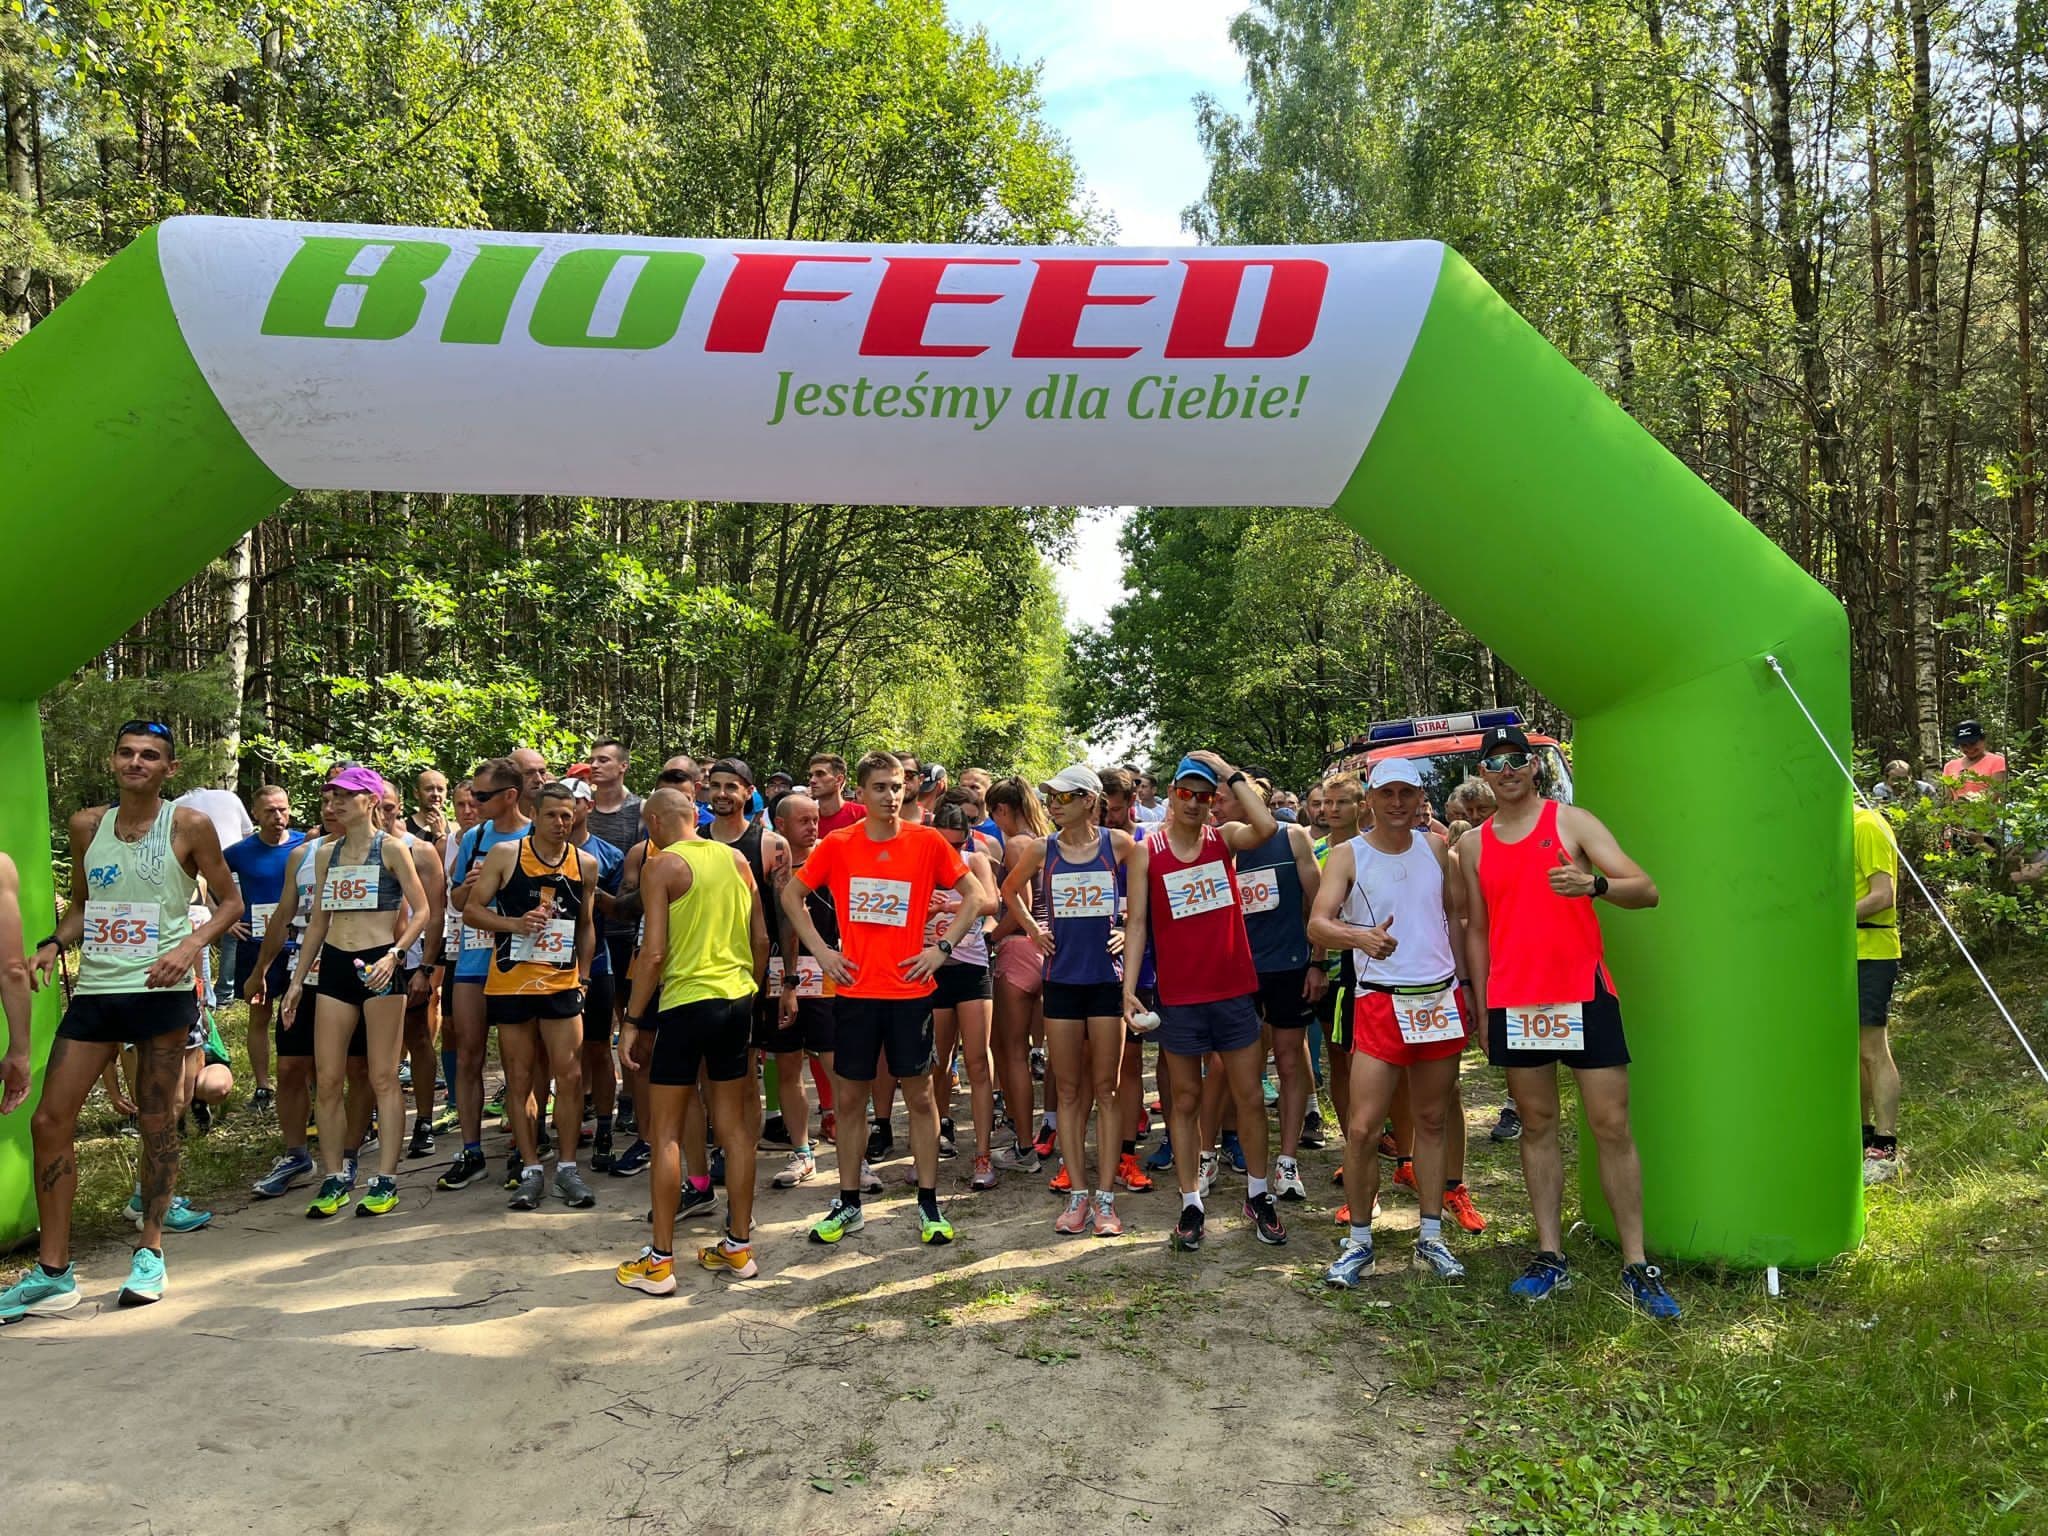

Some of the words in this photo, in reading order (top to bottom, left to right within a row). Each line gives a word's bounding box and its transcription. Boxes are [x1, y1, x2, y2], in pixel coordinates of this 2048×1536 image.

[260, 236, 1330, 359] BIOFEED
[767, 370, 1012, 431] Jesteśmy
[1025, 373, 1108, 420] dla
[1127, 373, 1311, 420] Ciebie!
[331, 879, 368, 900] 185
[1063, 885, 1104, 907] 212
[1181, 878, 1218, 906] 211
[1240, 883, 1269, 905] 90
[856, 891, 900, 915] 222
[94, 918, 147, 945] 363
[534, 931, 564, 952] 43
[777, 968, 813, 987] 12
[1404, 1004, 1449, 1032] 196
[1519, 1013, 1571, 1038] 105
